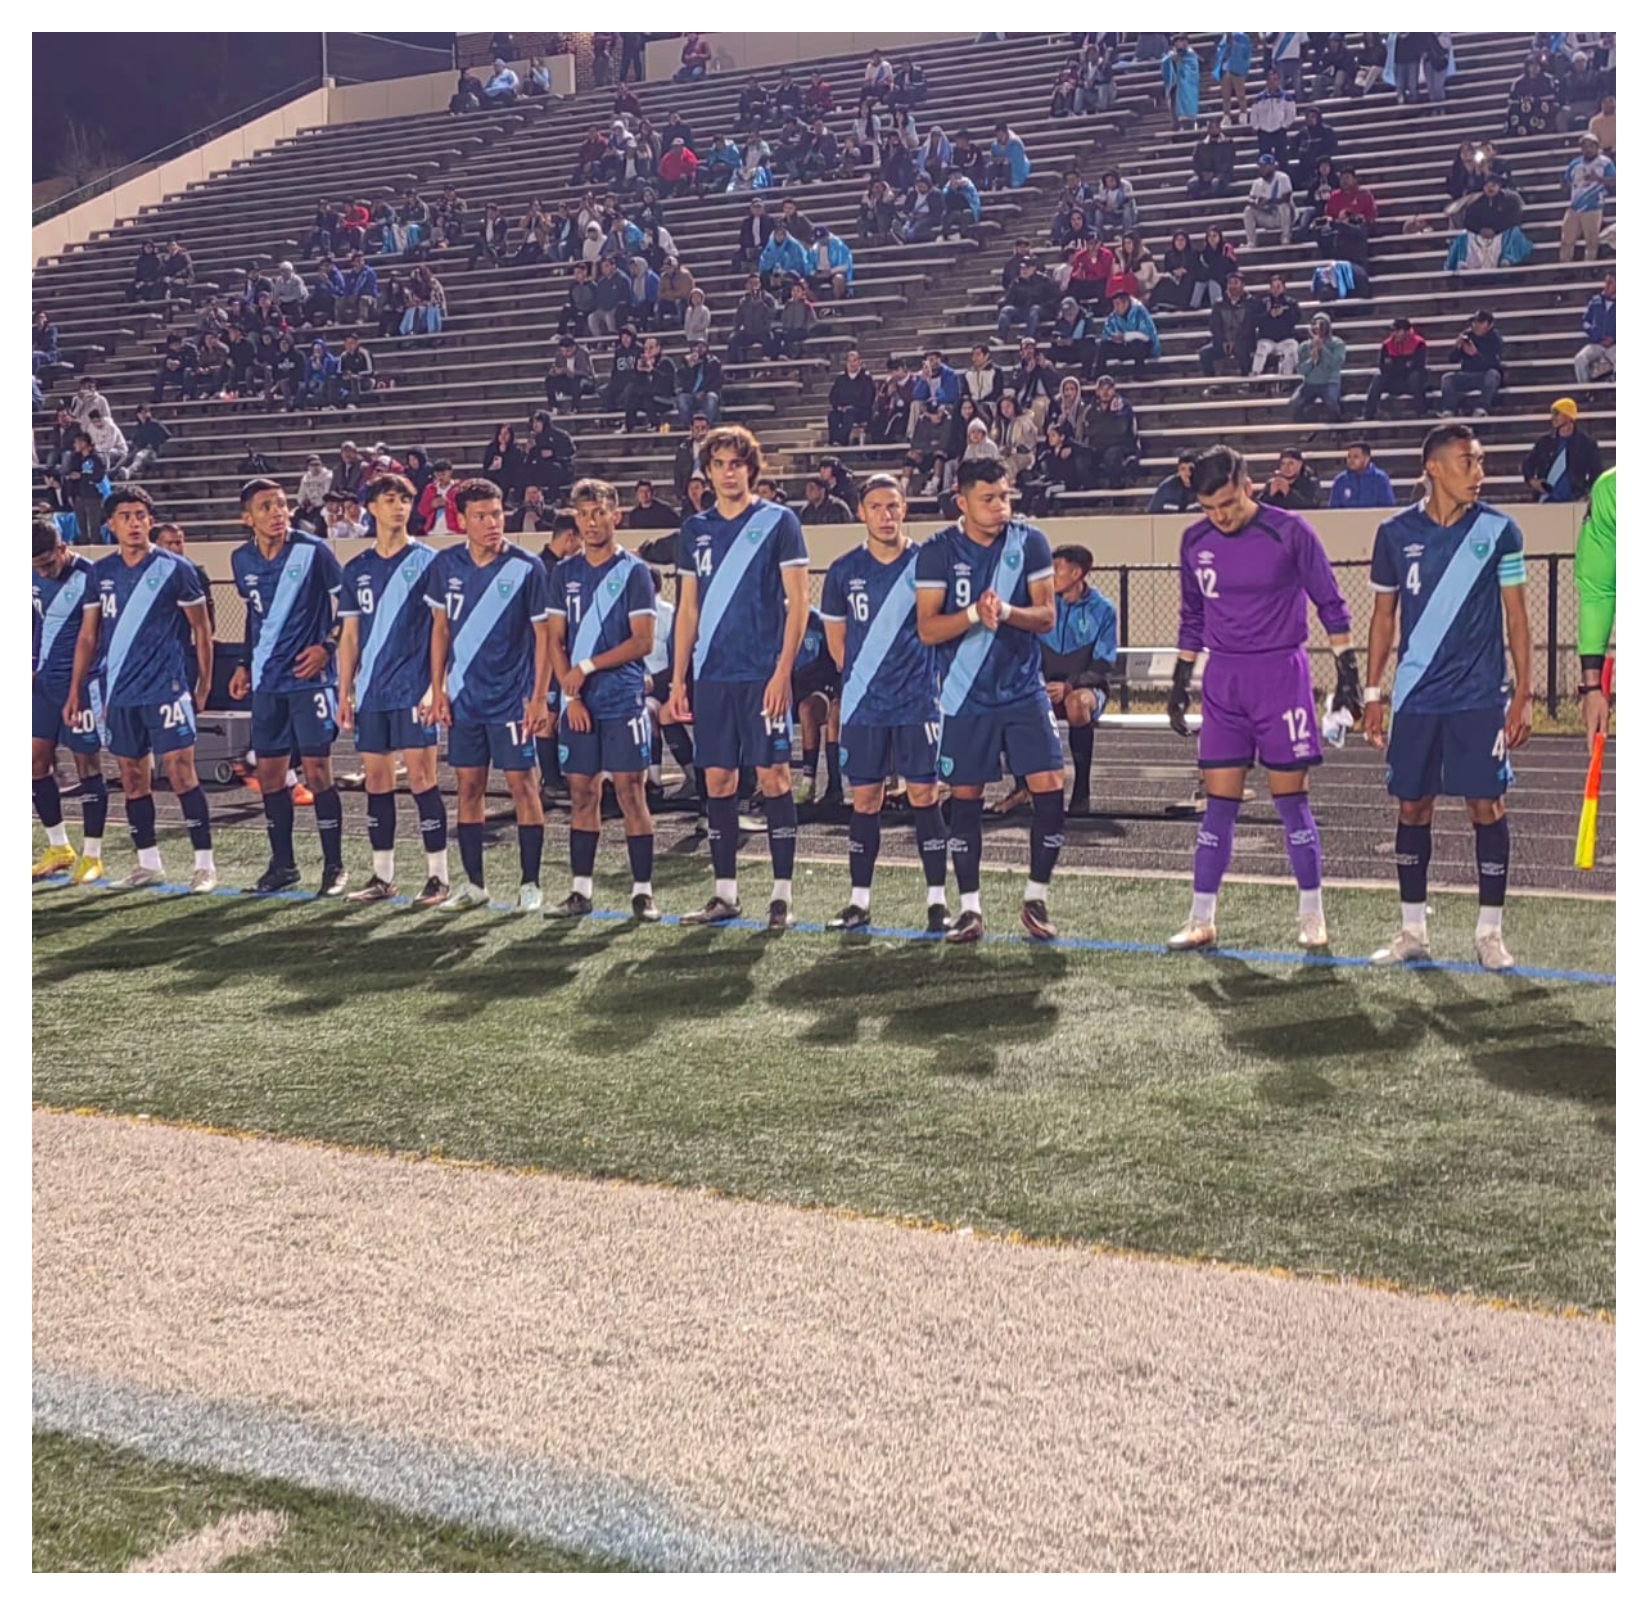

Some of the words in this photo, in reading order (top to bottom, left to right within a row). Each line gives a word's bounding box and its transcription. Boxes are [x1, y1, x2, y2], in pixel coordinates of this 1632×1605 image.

[693, 548, 713, 577] 14
[955, 578, 971, 607] 9
[1195, 568, 1220, 598] 12
[1406, 562, 1421, 595] 4
[250, 589, 263, 613] 3
[357, 588, 374, 614] 19
[445, 592, 464, 620] 17
[565, 594, 581, 623] 11
[847, 592, 869, 622] 16
[159, 701, 186, 729] 24
[313, 693, 328, 719] 3
[627, 717, 647, 745] 11
[1282, 707, 1311, 742] 12
